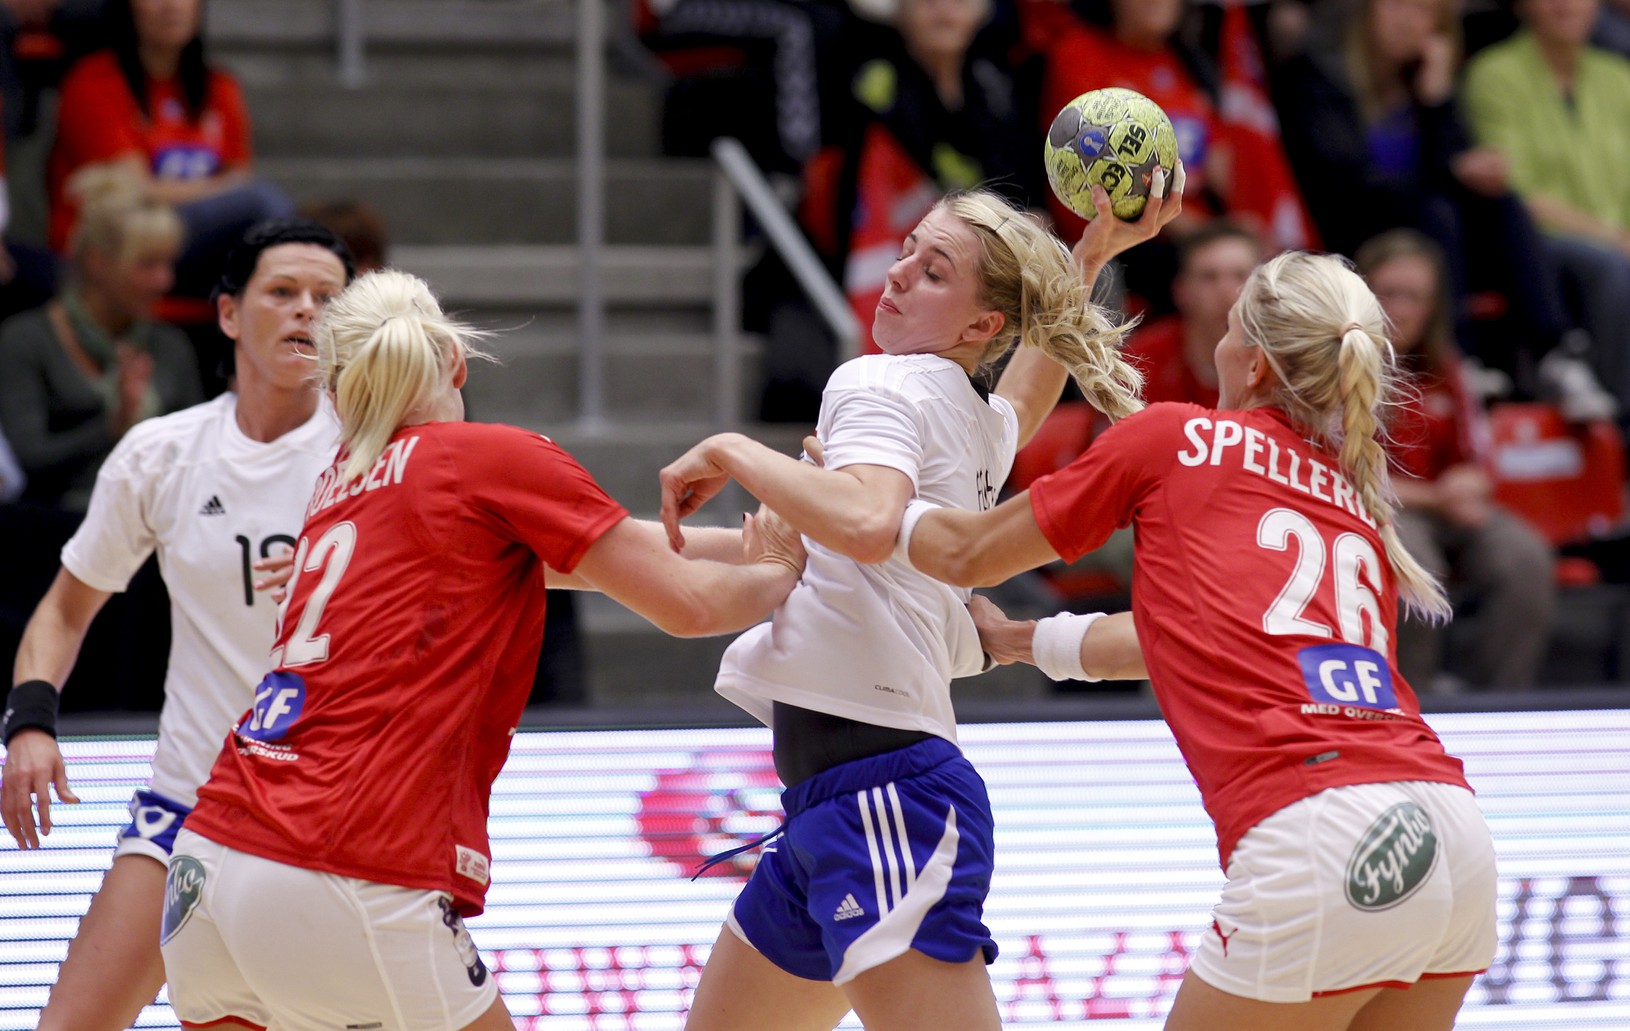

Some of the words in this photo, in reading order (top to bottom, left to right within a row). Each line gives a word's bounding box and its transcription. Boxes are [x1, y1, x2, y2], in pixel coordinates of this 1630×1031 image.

[1100, 163, 1126, 196] EC
[1256, 507, 1389, 658] 26
[1318, 659, 1382, 704] GF
[1301, 703, 1341, 715] MED
[833, 907, 865, 921] adidas
